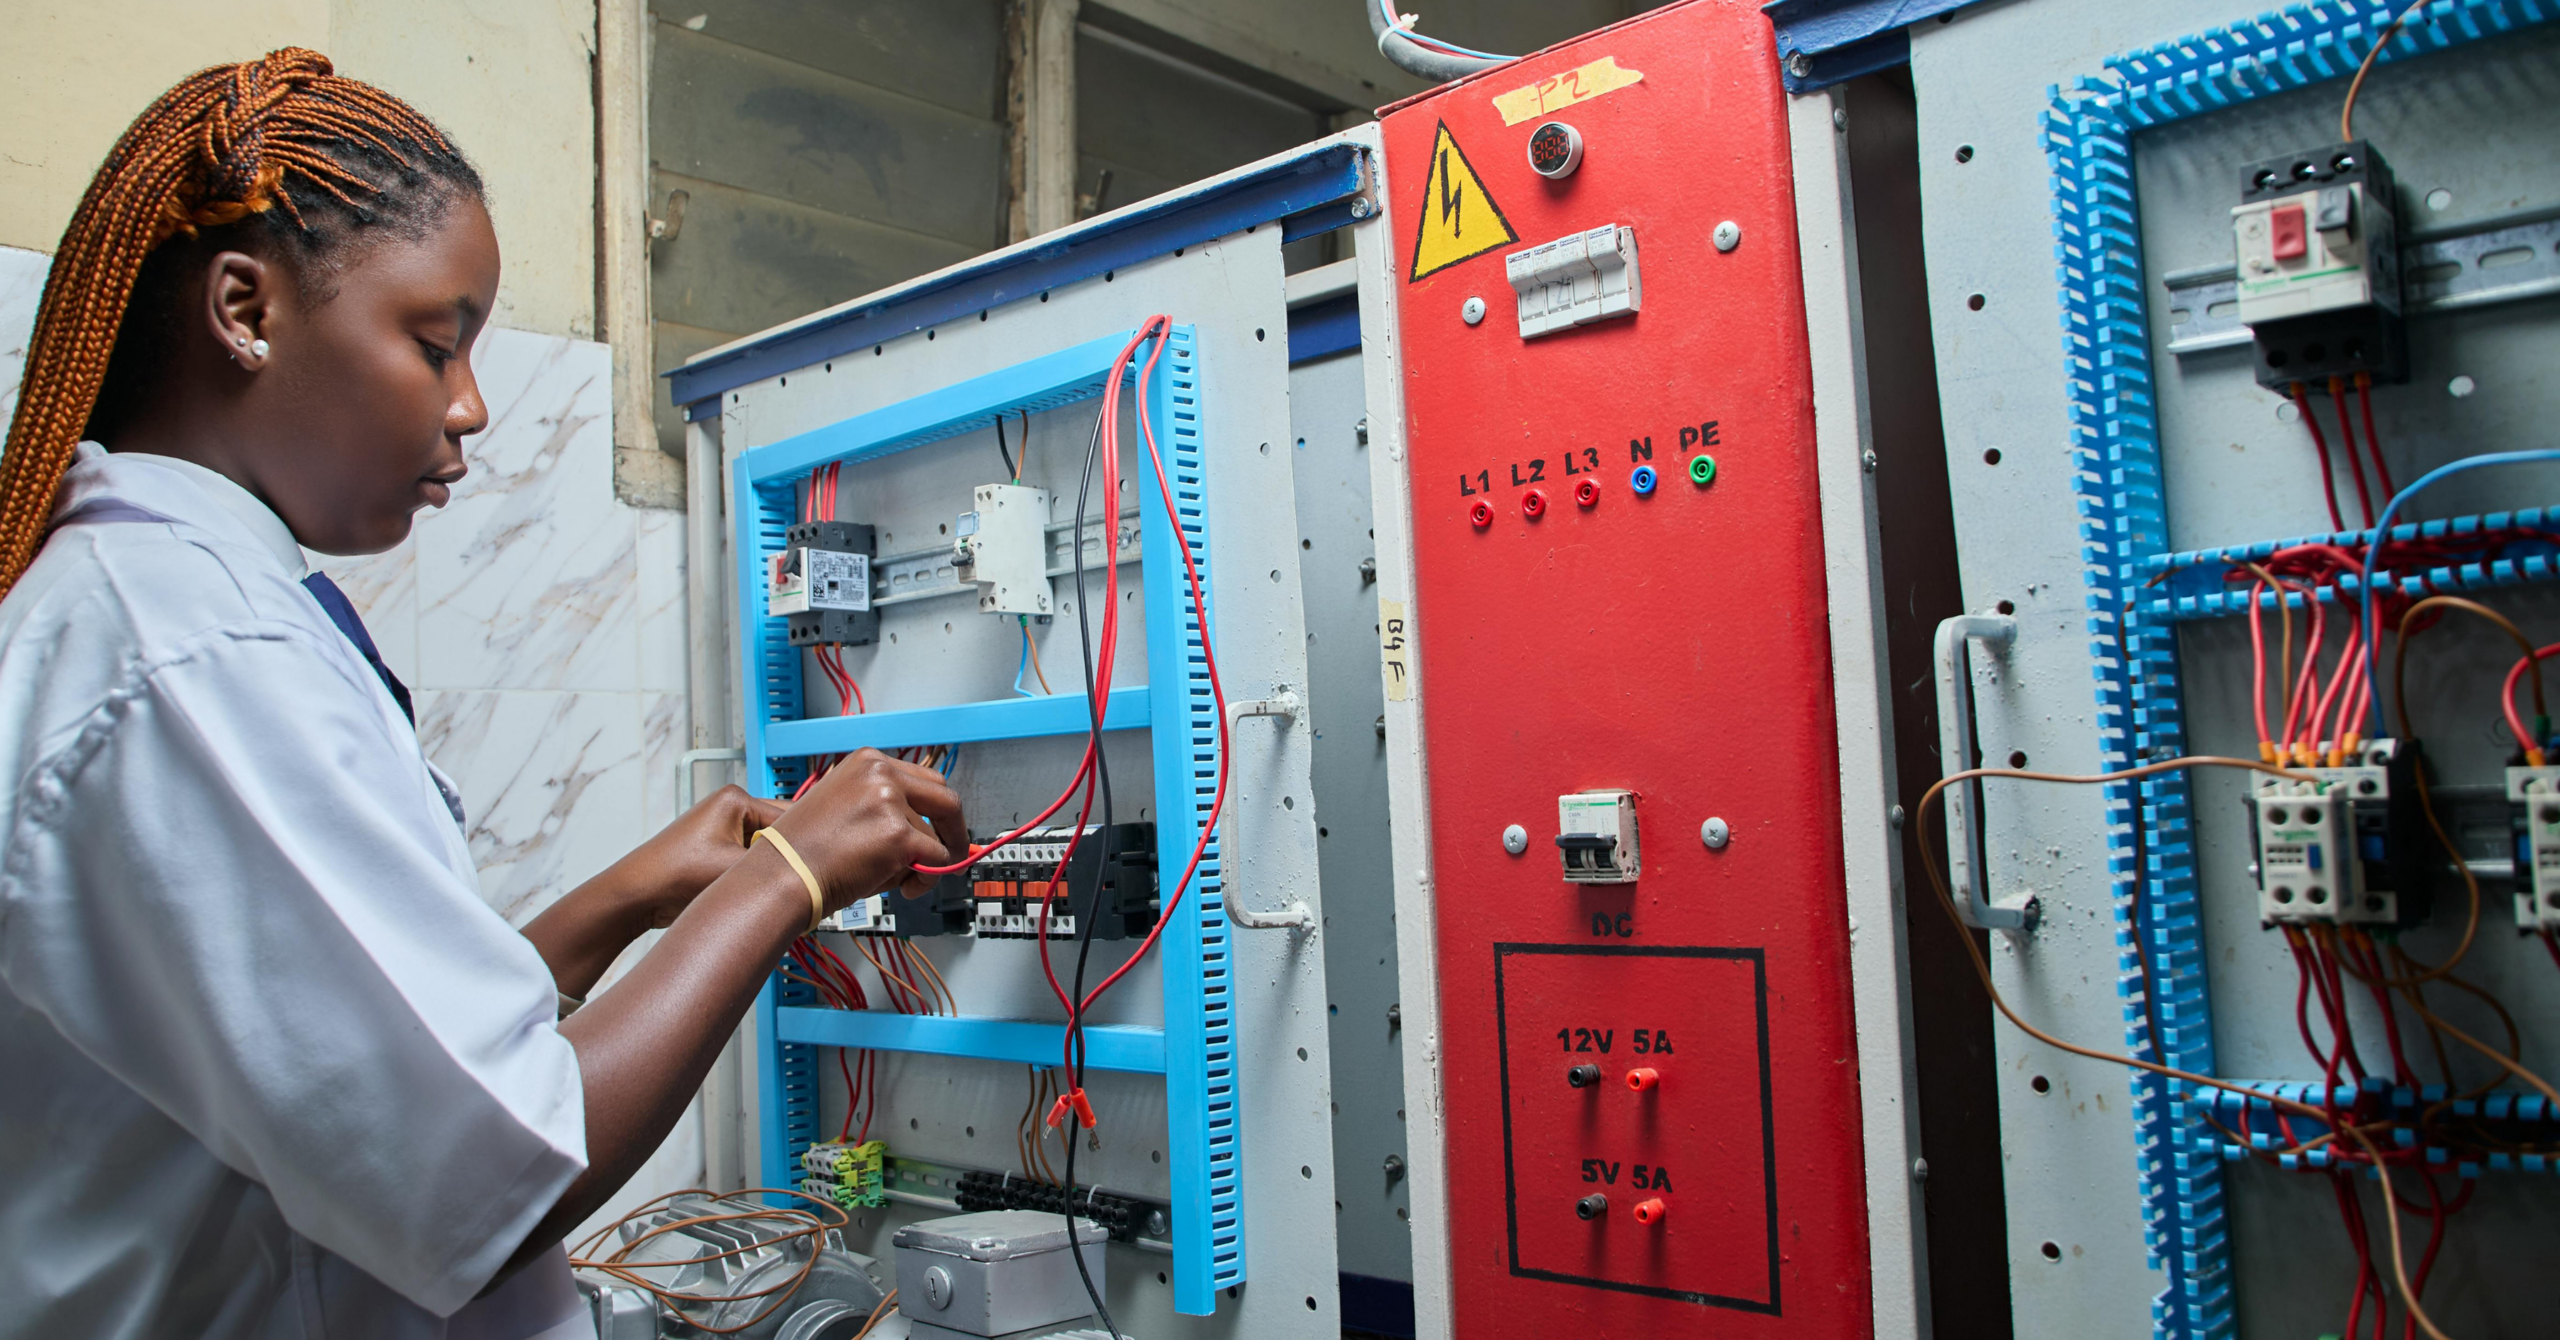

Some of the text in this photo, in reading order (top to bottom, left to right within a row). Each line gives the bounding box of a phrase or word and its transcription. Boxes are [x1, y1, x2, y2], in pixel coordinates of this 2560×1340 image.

[1460, 420, 1721, 497] L1 L2 L3 N PE
[1591, 912, 1633, 938] DC
[1557, 1027, 1674, 1055] 12V 5A
[1581, 1158, 1673, 1194] 5V 5A
